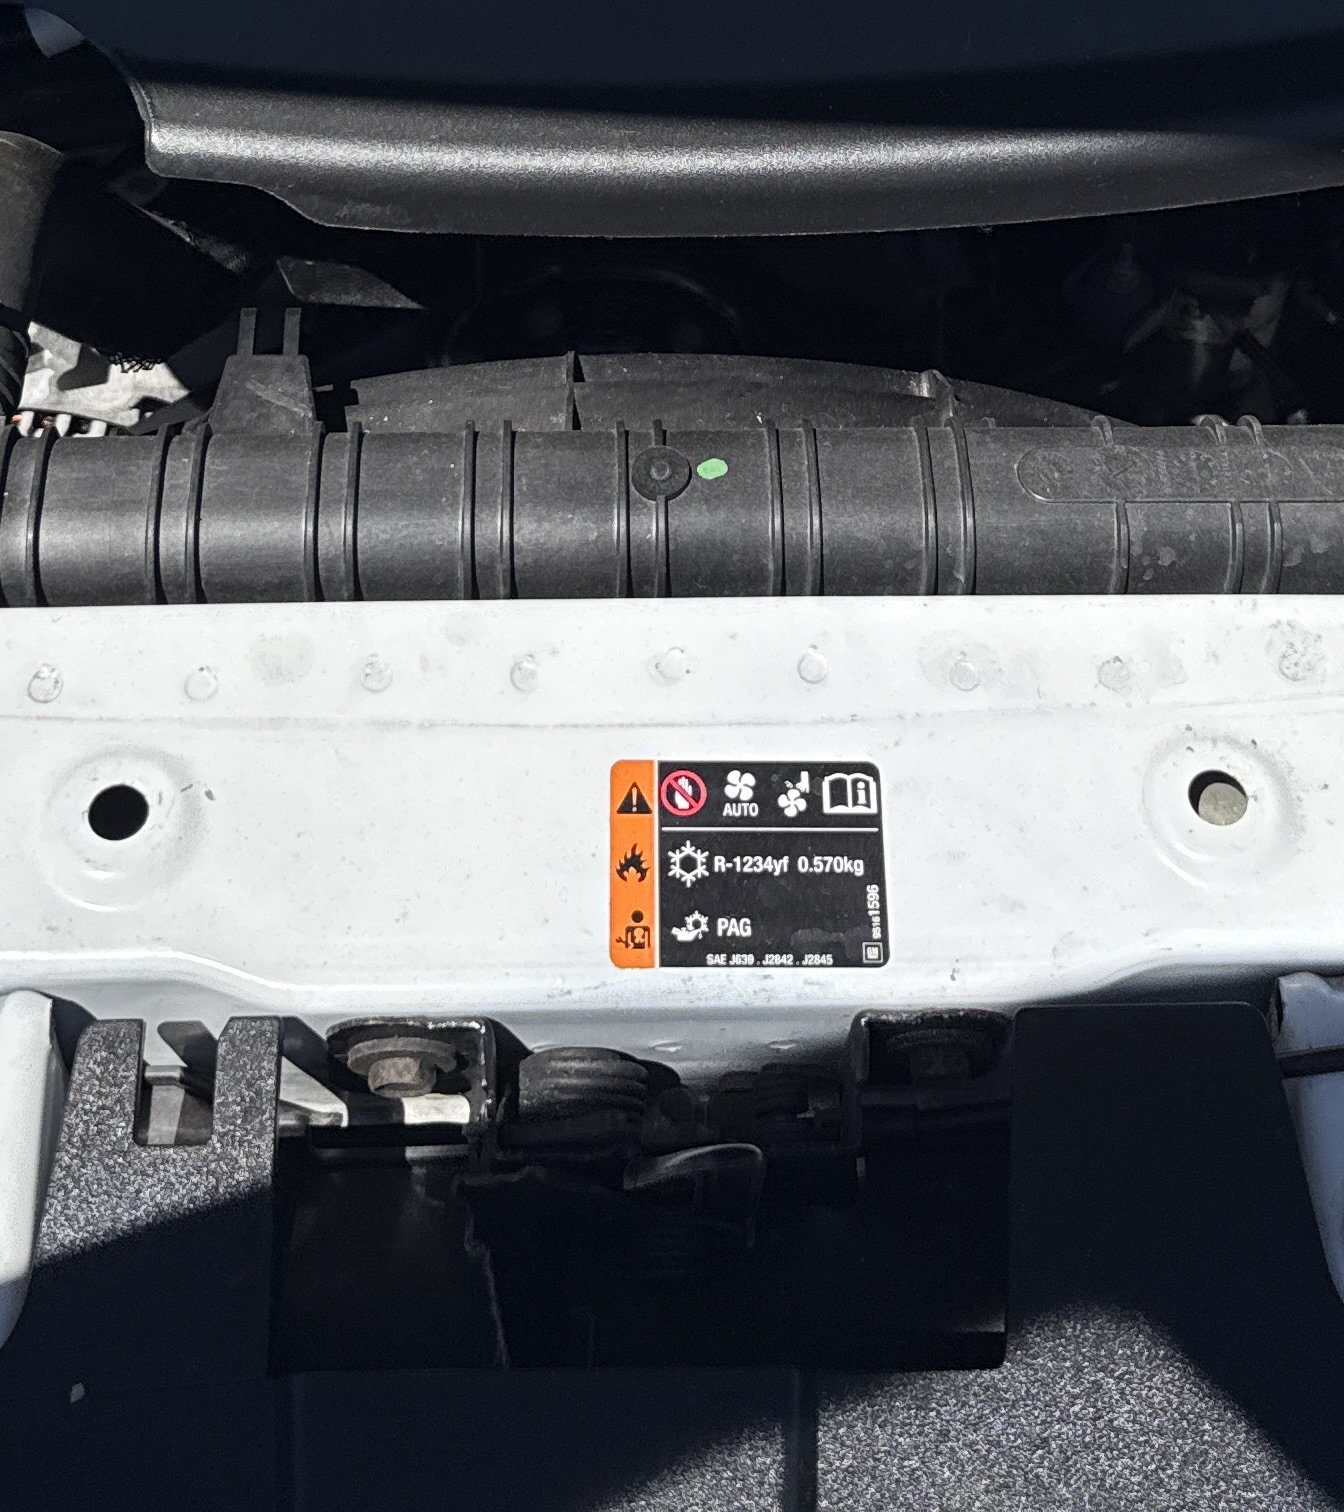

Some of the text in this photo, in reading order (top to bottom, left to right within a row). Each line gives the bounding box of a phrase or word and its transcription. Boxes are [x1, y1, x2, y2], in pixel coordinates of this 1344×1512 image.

[722, 802, 759, 818] AUTO
[713, 856, 865, 876] R-1234yf 0.570kg
[716, 917, 753, 938] PAG
[706, 953, 727, 966] SAE
